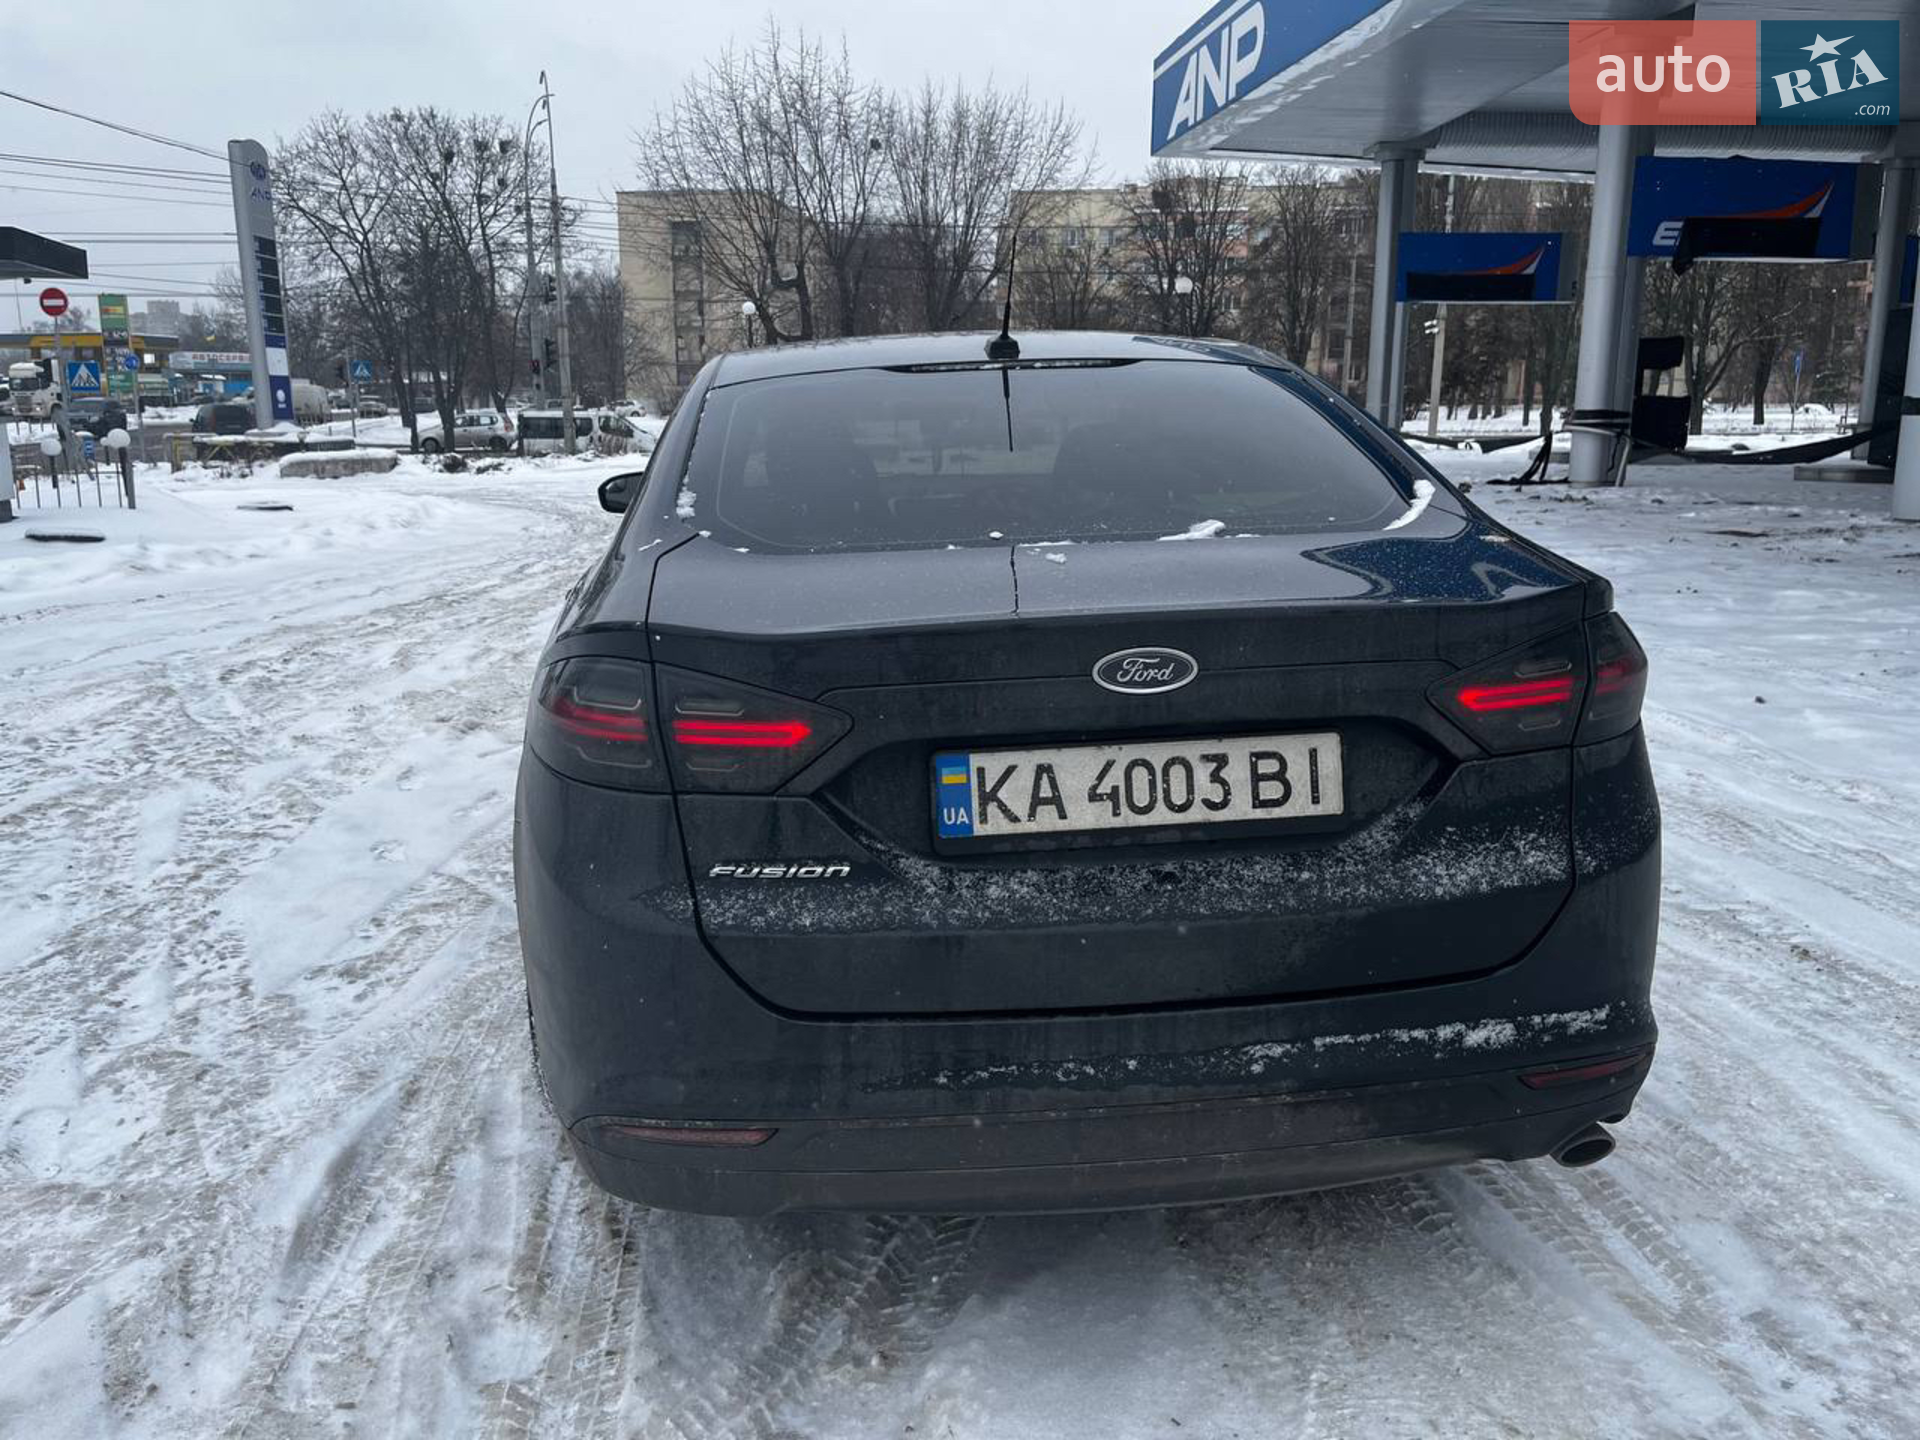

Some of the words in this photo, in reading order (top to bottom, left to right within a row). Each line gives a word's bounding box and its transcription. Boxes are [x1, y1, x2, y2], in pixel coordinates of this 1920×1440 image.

[1167, 1, 1265, 141] ANP
[1116, 657, 1176, 683] Ford
[976, 762, 1068, 825] KA
[1087, 752, 1232, 817] 4003
[1248, 747, 1321, 810] BI
[943, 807, 970, 826] UA
[708, 864, 852, 879] FUSION
